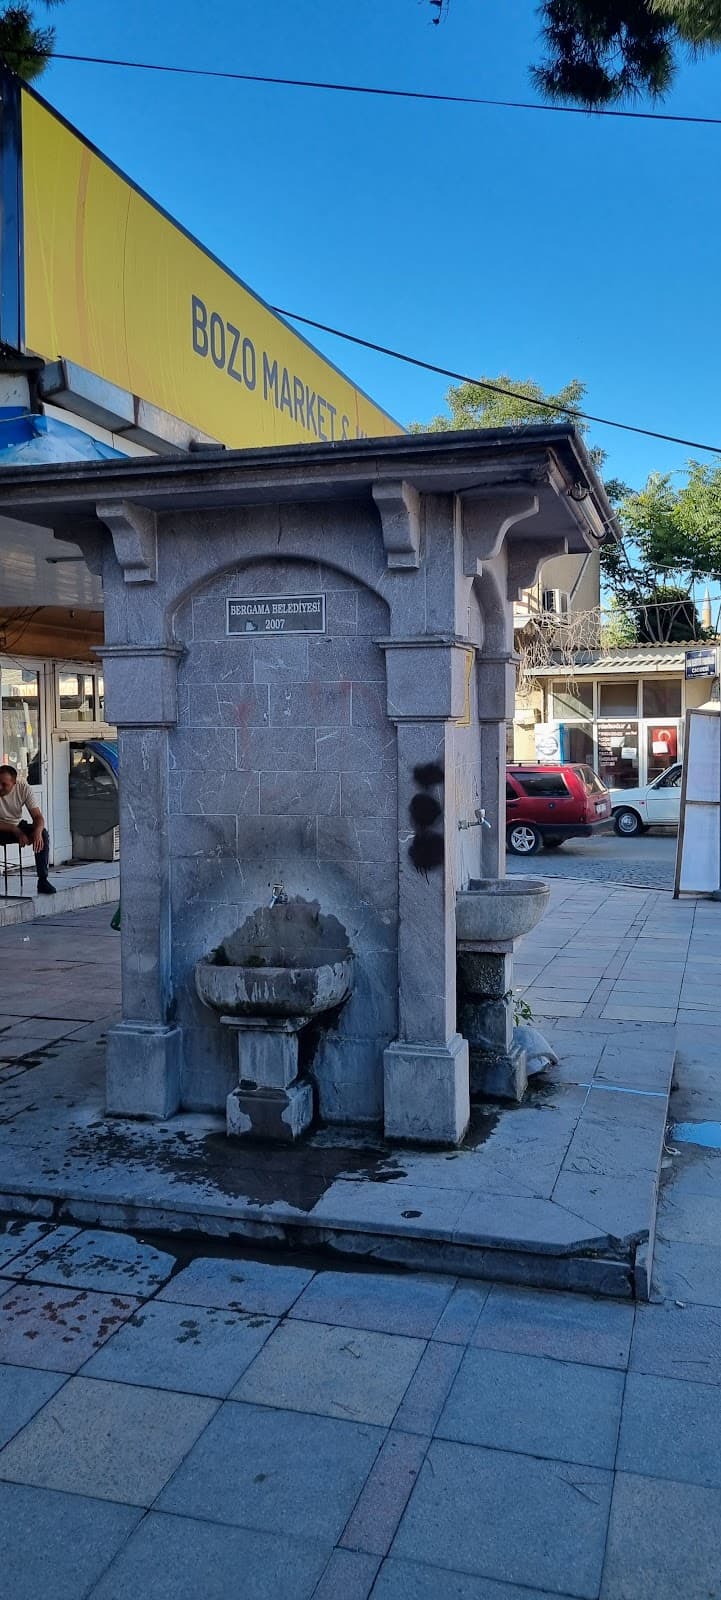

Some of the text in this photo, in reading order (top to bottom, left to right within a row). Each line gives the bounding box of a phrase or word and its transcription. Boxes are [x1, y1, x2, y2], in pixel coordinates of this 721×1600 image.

[191, 294, 256, 391] BOZO
[262, 351, 337, 442] MARKET
[230, 600, 320, 615] BERGAMA BELEDİYESİ
[265, 618, 285, 630] 2007
